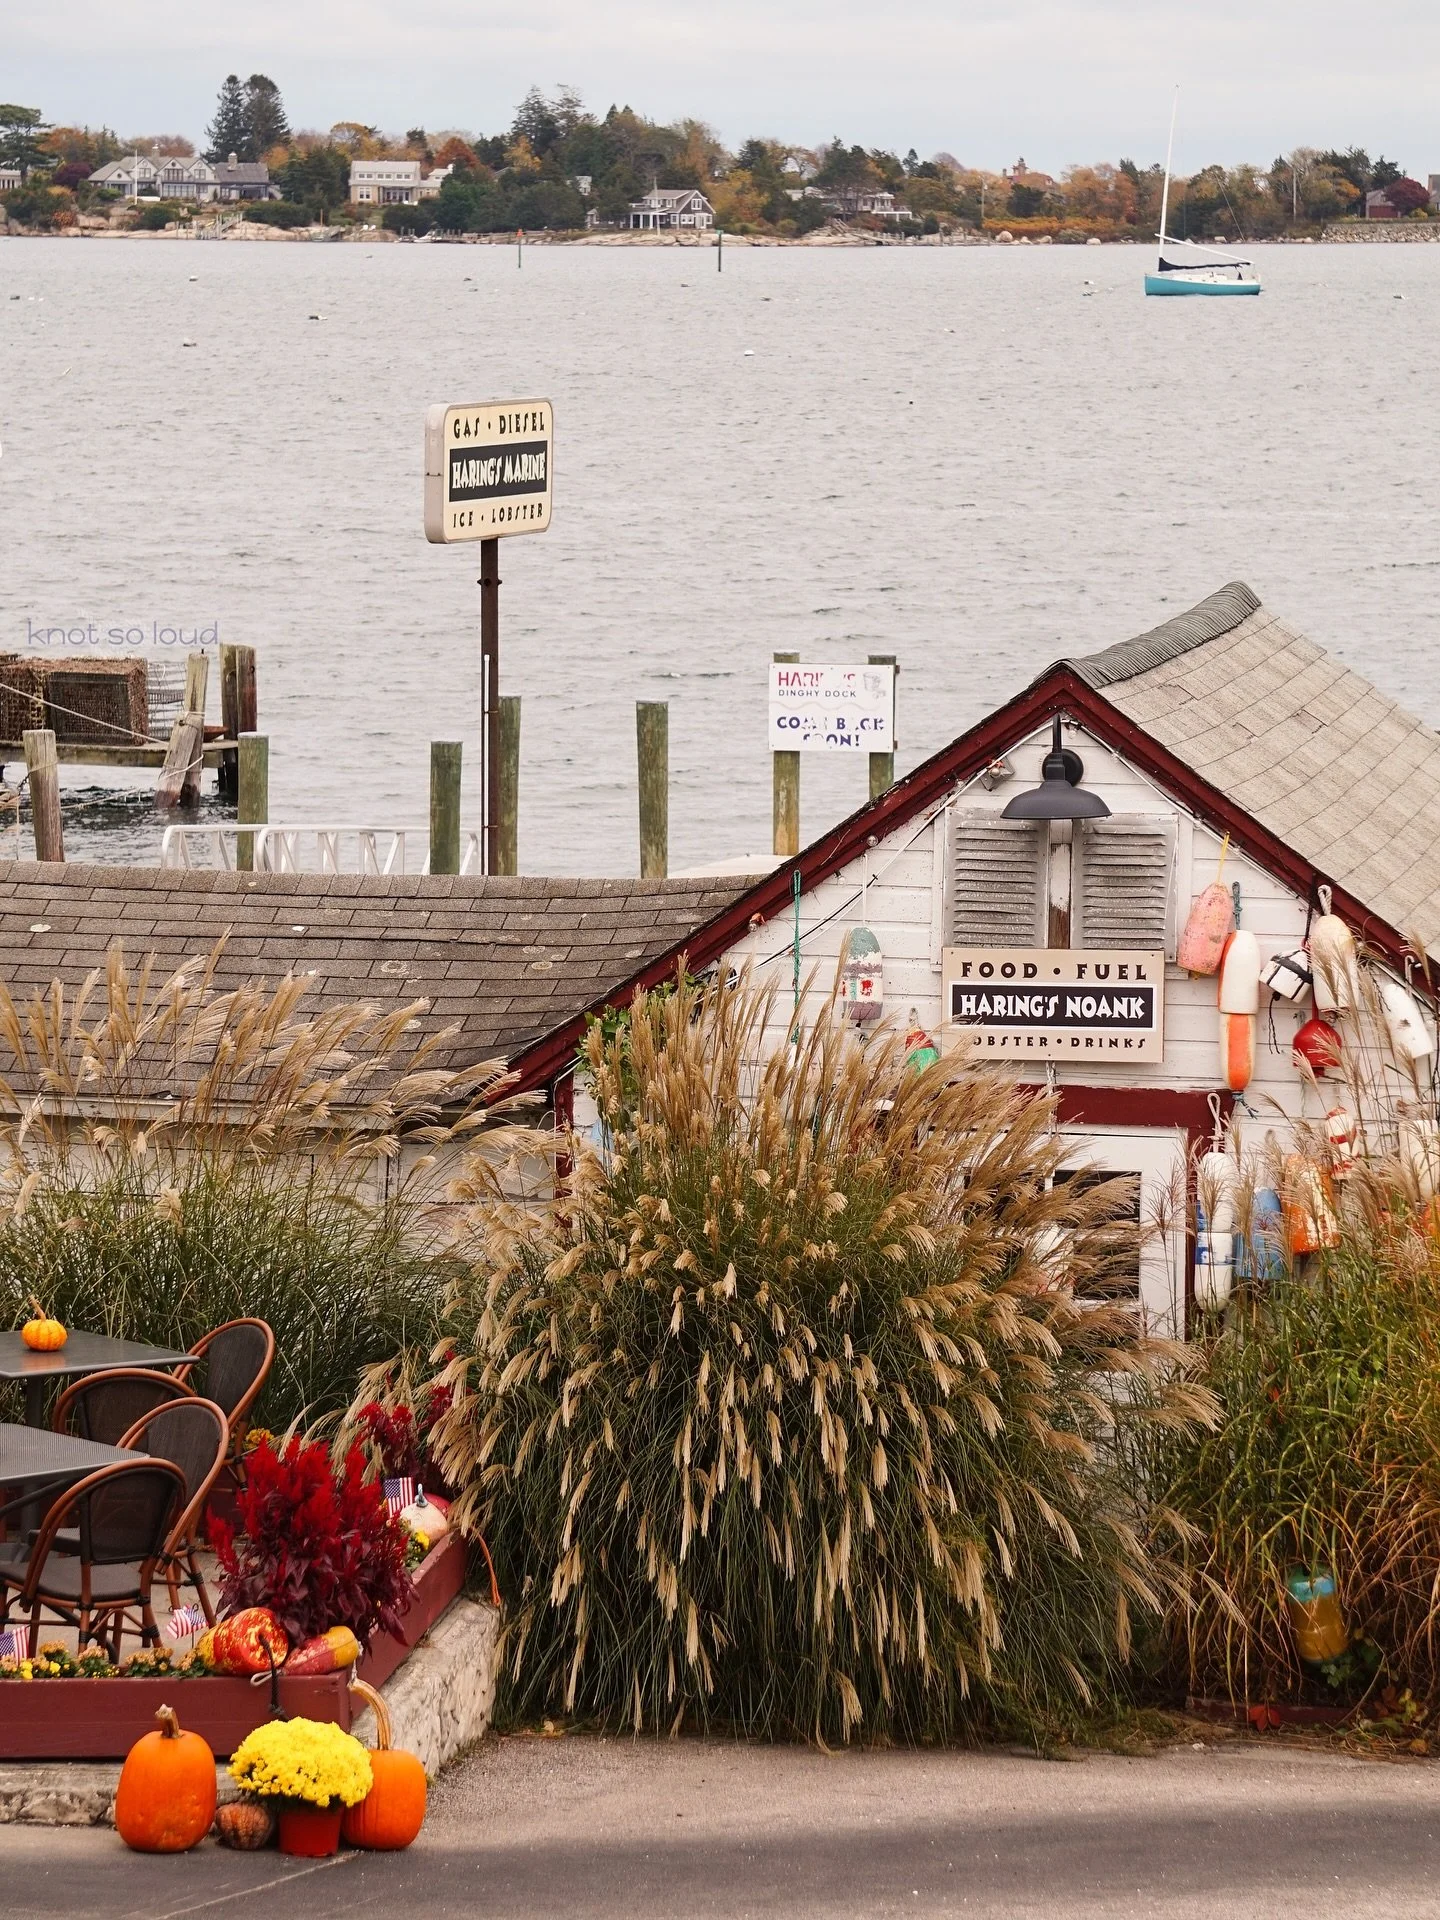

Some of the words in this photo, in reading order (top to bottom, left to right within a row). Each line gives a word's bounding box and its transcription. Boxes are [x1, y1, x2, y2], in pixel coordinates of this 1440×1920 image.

[453, 417, 480, 439] GAS
[499, 412, 545, 434] DIESEL
[452, 456, 502, 489] HARING'S
[503, 452, 545, 484] MARINE
[453, 511, 474, 528] ICE
[491, 503, 543, 523] LOBSTER
[778, 689, 820, 697] DINGHY
[825, 690, 857, 698] DOCK
[961, 961, 1038, 979] FOOD
[1076, 963, 1147, 981] FUEL
[960, 993, 1059, 1019] HARING'S
[1065, 994, 1146, 1020] NOANK
[973, 1035, 1048, 1047] OBSTER
[1070, 1037, 1146, 1049] DRINKS
